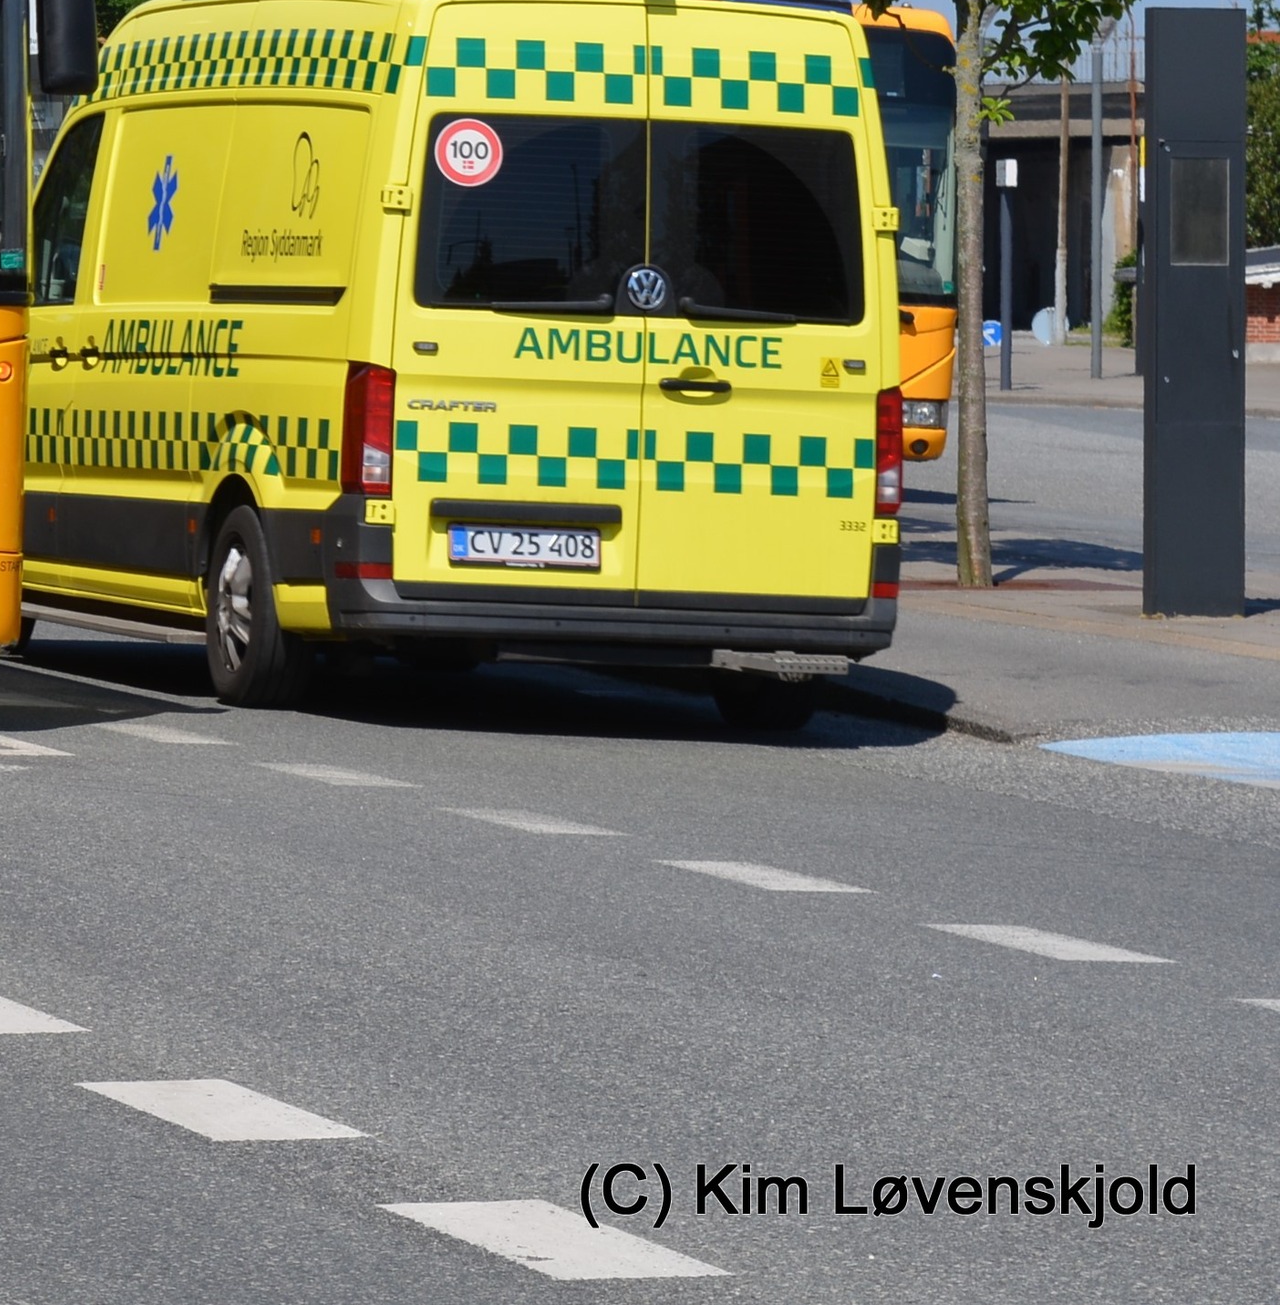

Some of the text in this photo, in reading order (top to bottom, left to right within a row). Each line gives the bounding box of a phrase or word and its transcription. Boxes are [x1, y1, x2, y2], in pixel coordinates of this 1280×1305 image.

[450, 140, 489, 160] 100
[240, 228, 322, 263] Region Syddanmark
[101, 319, 243, 377] AMBULANCE
[514, 327, 783, 369] AMBULANCE
[407, 399, 497, 413] CRAFTER
[840, 521, 866, 532] 3332
[471, 530, 595, 559] CV 25 408
